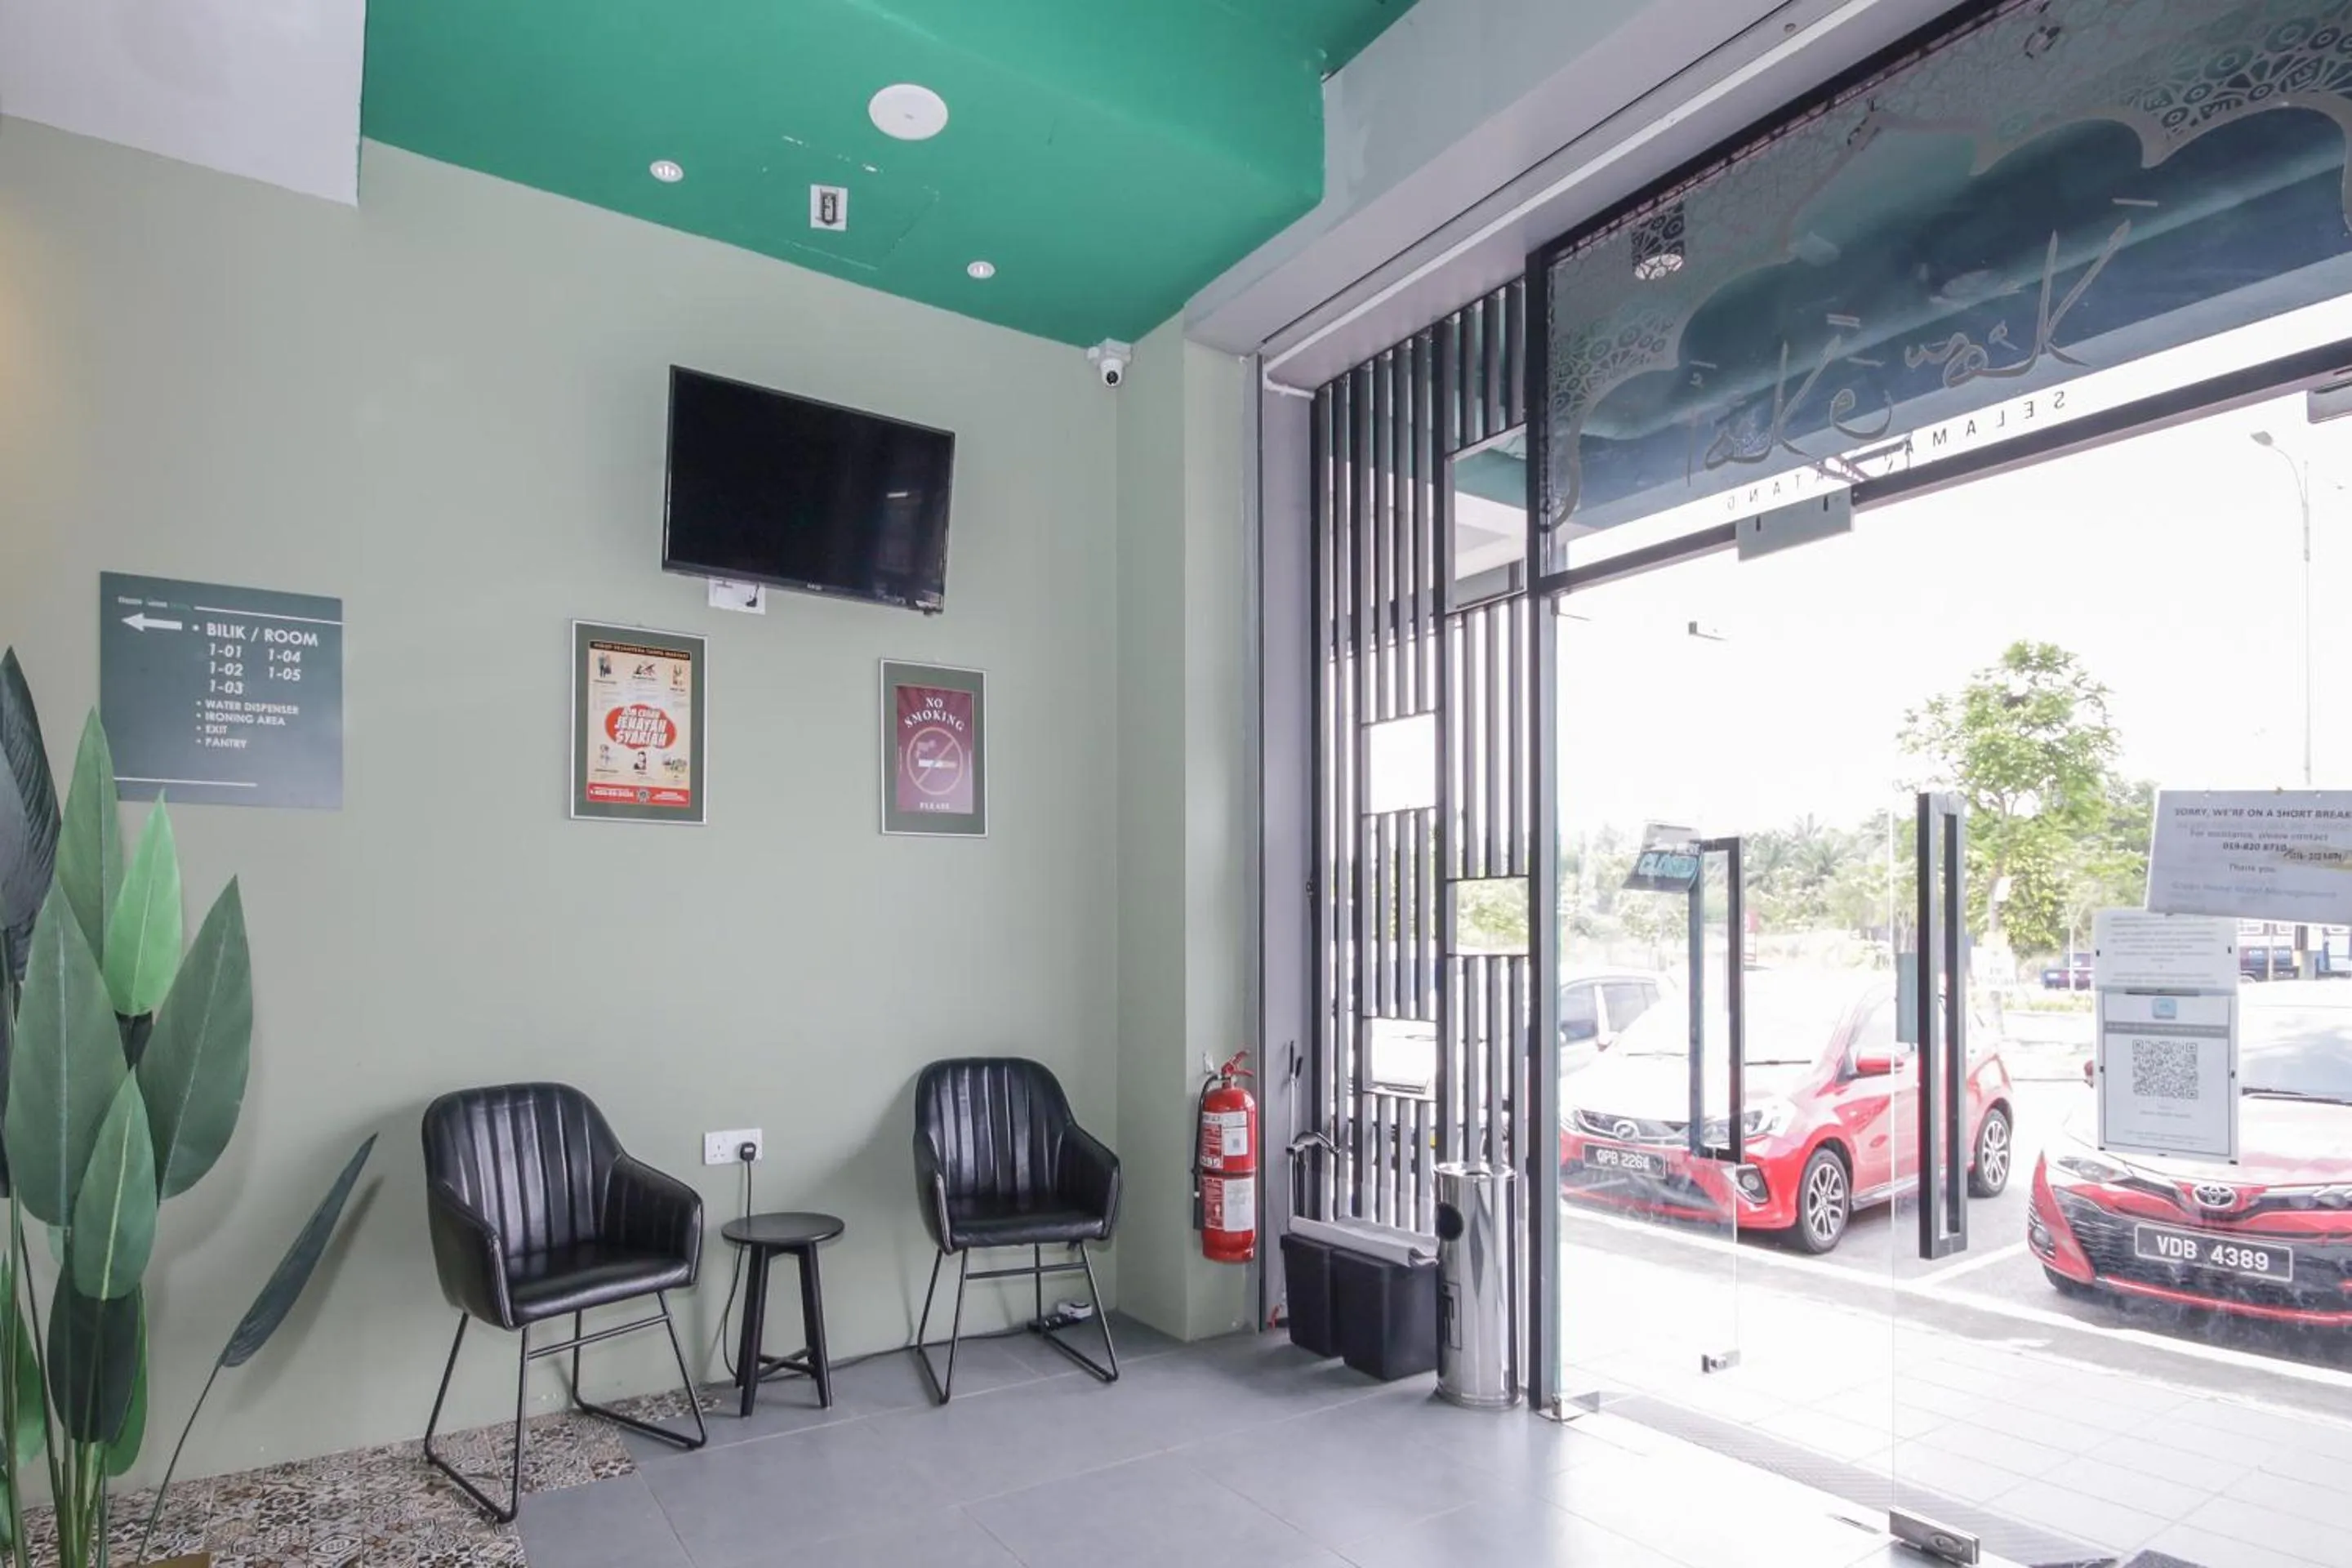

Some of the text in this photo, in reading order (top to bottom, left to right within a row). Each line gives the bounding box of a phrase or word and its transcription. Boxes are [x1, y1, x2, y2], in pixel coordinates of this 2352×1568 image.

[206, 622, 246, 639] BILIK
[264, 628, 318, 647] ROOM
[210, 643, 242, 658] 1-01
[268, 648, 301, 663] 1-04
[210, 661, 244, 676] 1-02
[268, 666, 301, 681] 1-05
[210, 679, 244, 694] 1-03
[205, 699, 300, 715] WATER DISPENSER
[925, 697, 943, 708] NO
[205, 711, 286, 726] IRONING AREA
[904, 710, 964, 732] SMOKING
[205, 724, 228, 734] EXIT
[205, 737, 247, 748] PANTRY
[2247, 809, 2263, 817] ON
[2156, 1234, 2270, 1272] VDB 4389
